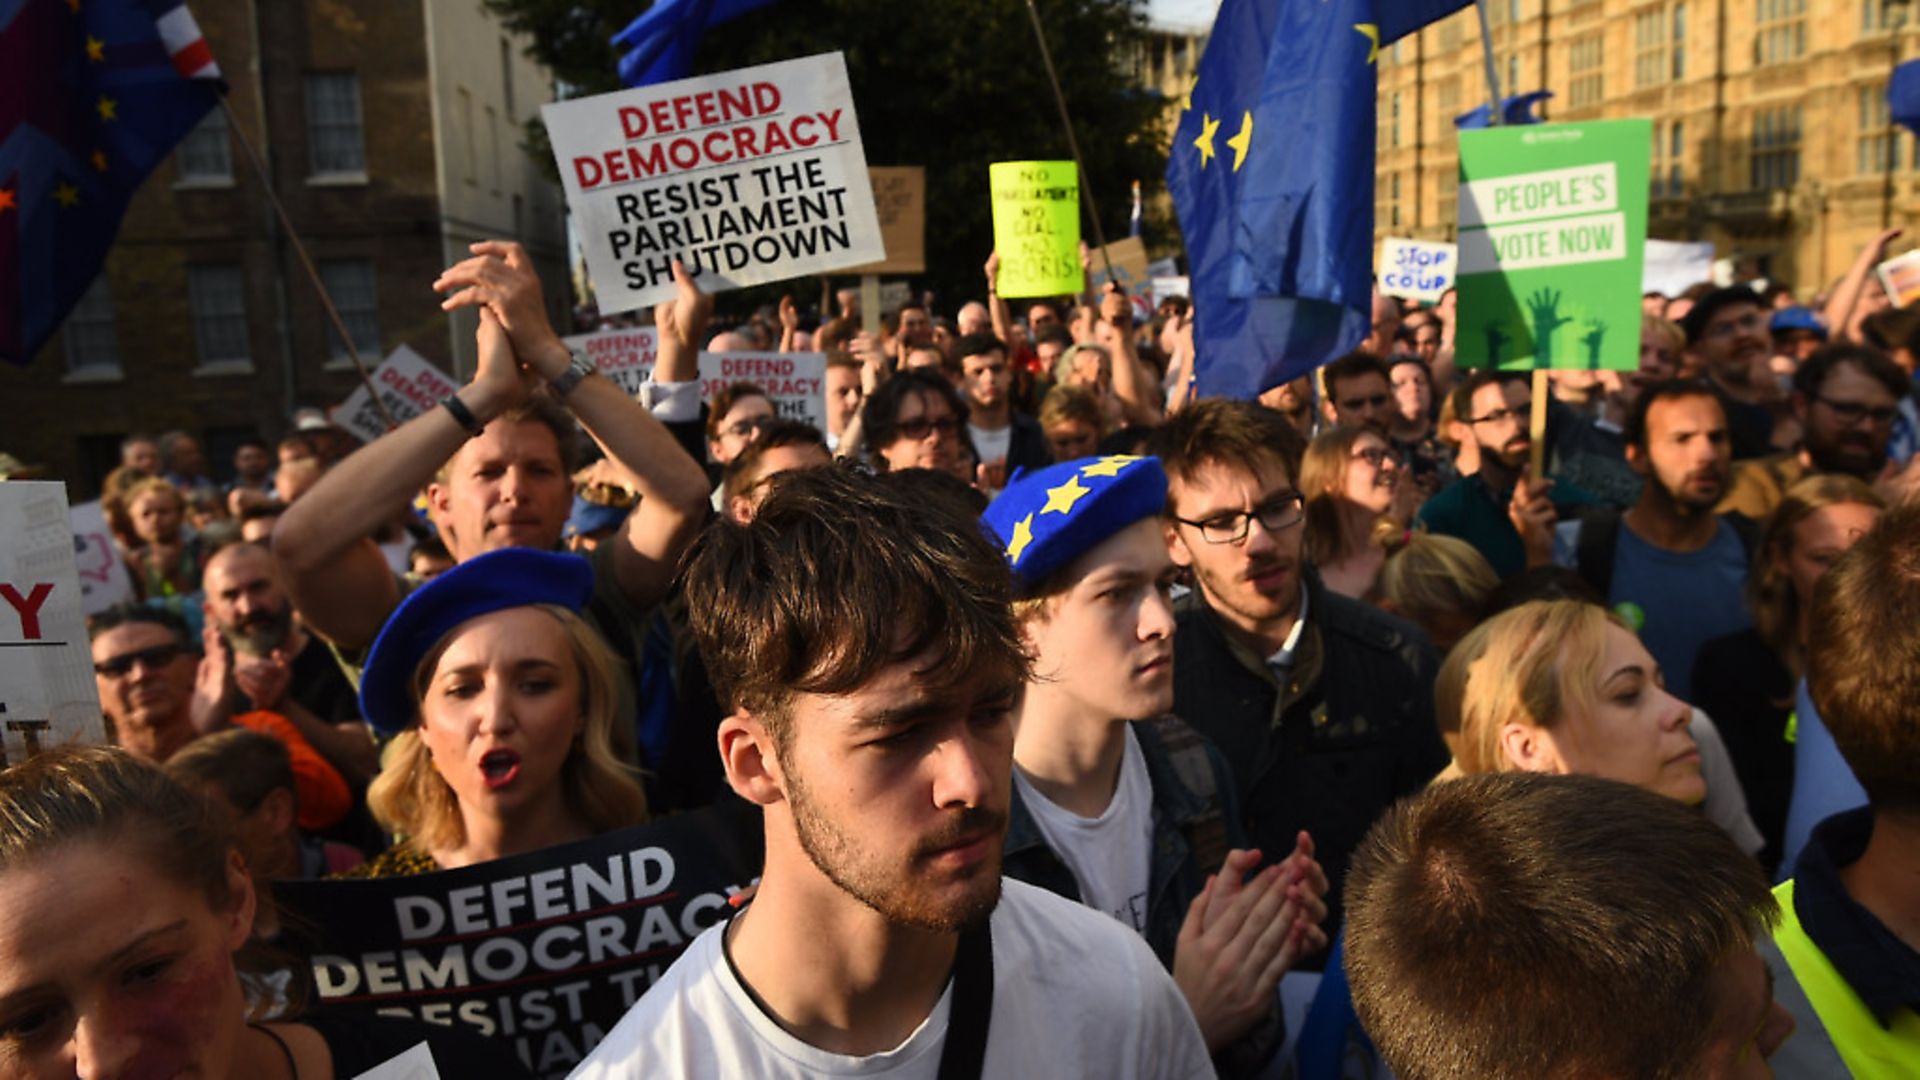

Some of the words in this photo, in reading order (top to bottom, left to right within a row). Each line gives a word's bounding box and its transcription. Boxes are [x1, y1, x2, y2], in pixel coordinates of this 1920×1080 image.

[618, 81, 782, 140] DEFEND
[573, 109, 843, 189] DEMOCRACY
[616, 173, 741, 224] RESIST
[752, 158, 826, 198] THE
[1020, 168, 1050, 182] NO
[1494, 174, 1607, 213] PEOPLE'S
[608, 187, 847, 260] PARLIAMENT
[1490, 229, 1550, 261] VOTE
[1558, 223, 1615, 255] NOW
[622, 221, 850, 290] SHUTDOWN
[1394, 247, 1448, 266] STOP
[1385, 273, 1447, 290] COUP
[586, 331, 653, 355] DEFEND
[721, 358, 795, 377] DEFEND
[394, 846, 675, 940] DEFEND
[376, 980, 590, 1037] ESIST
